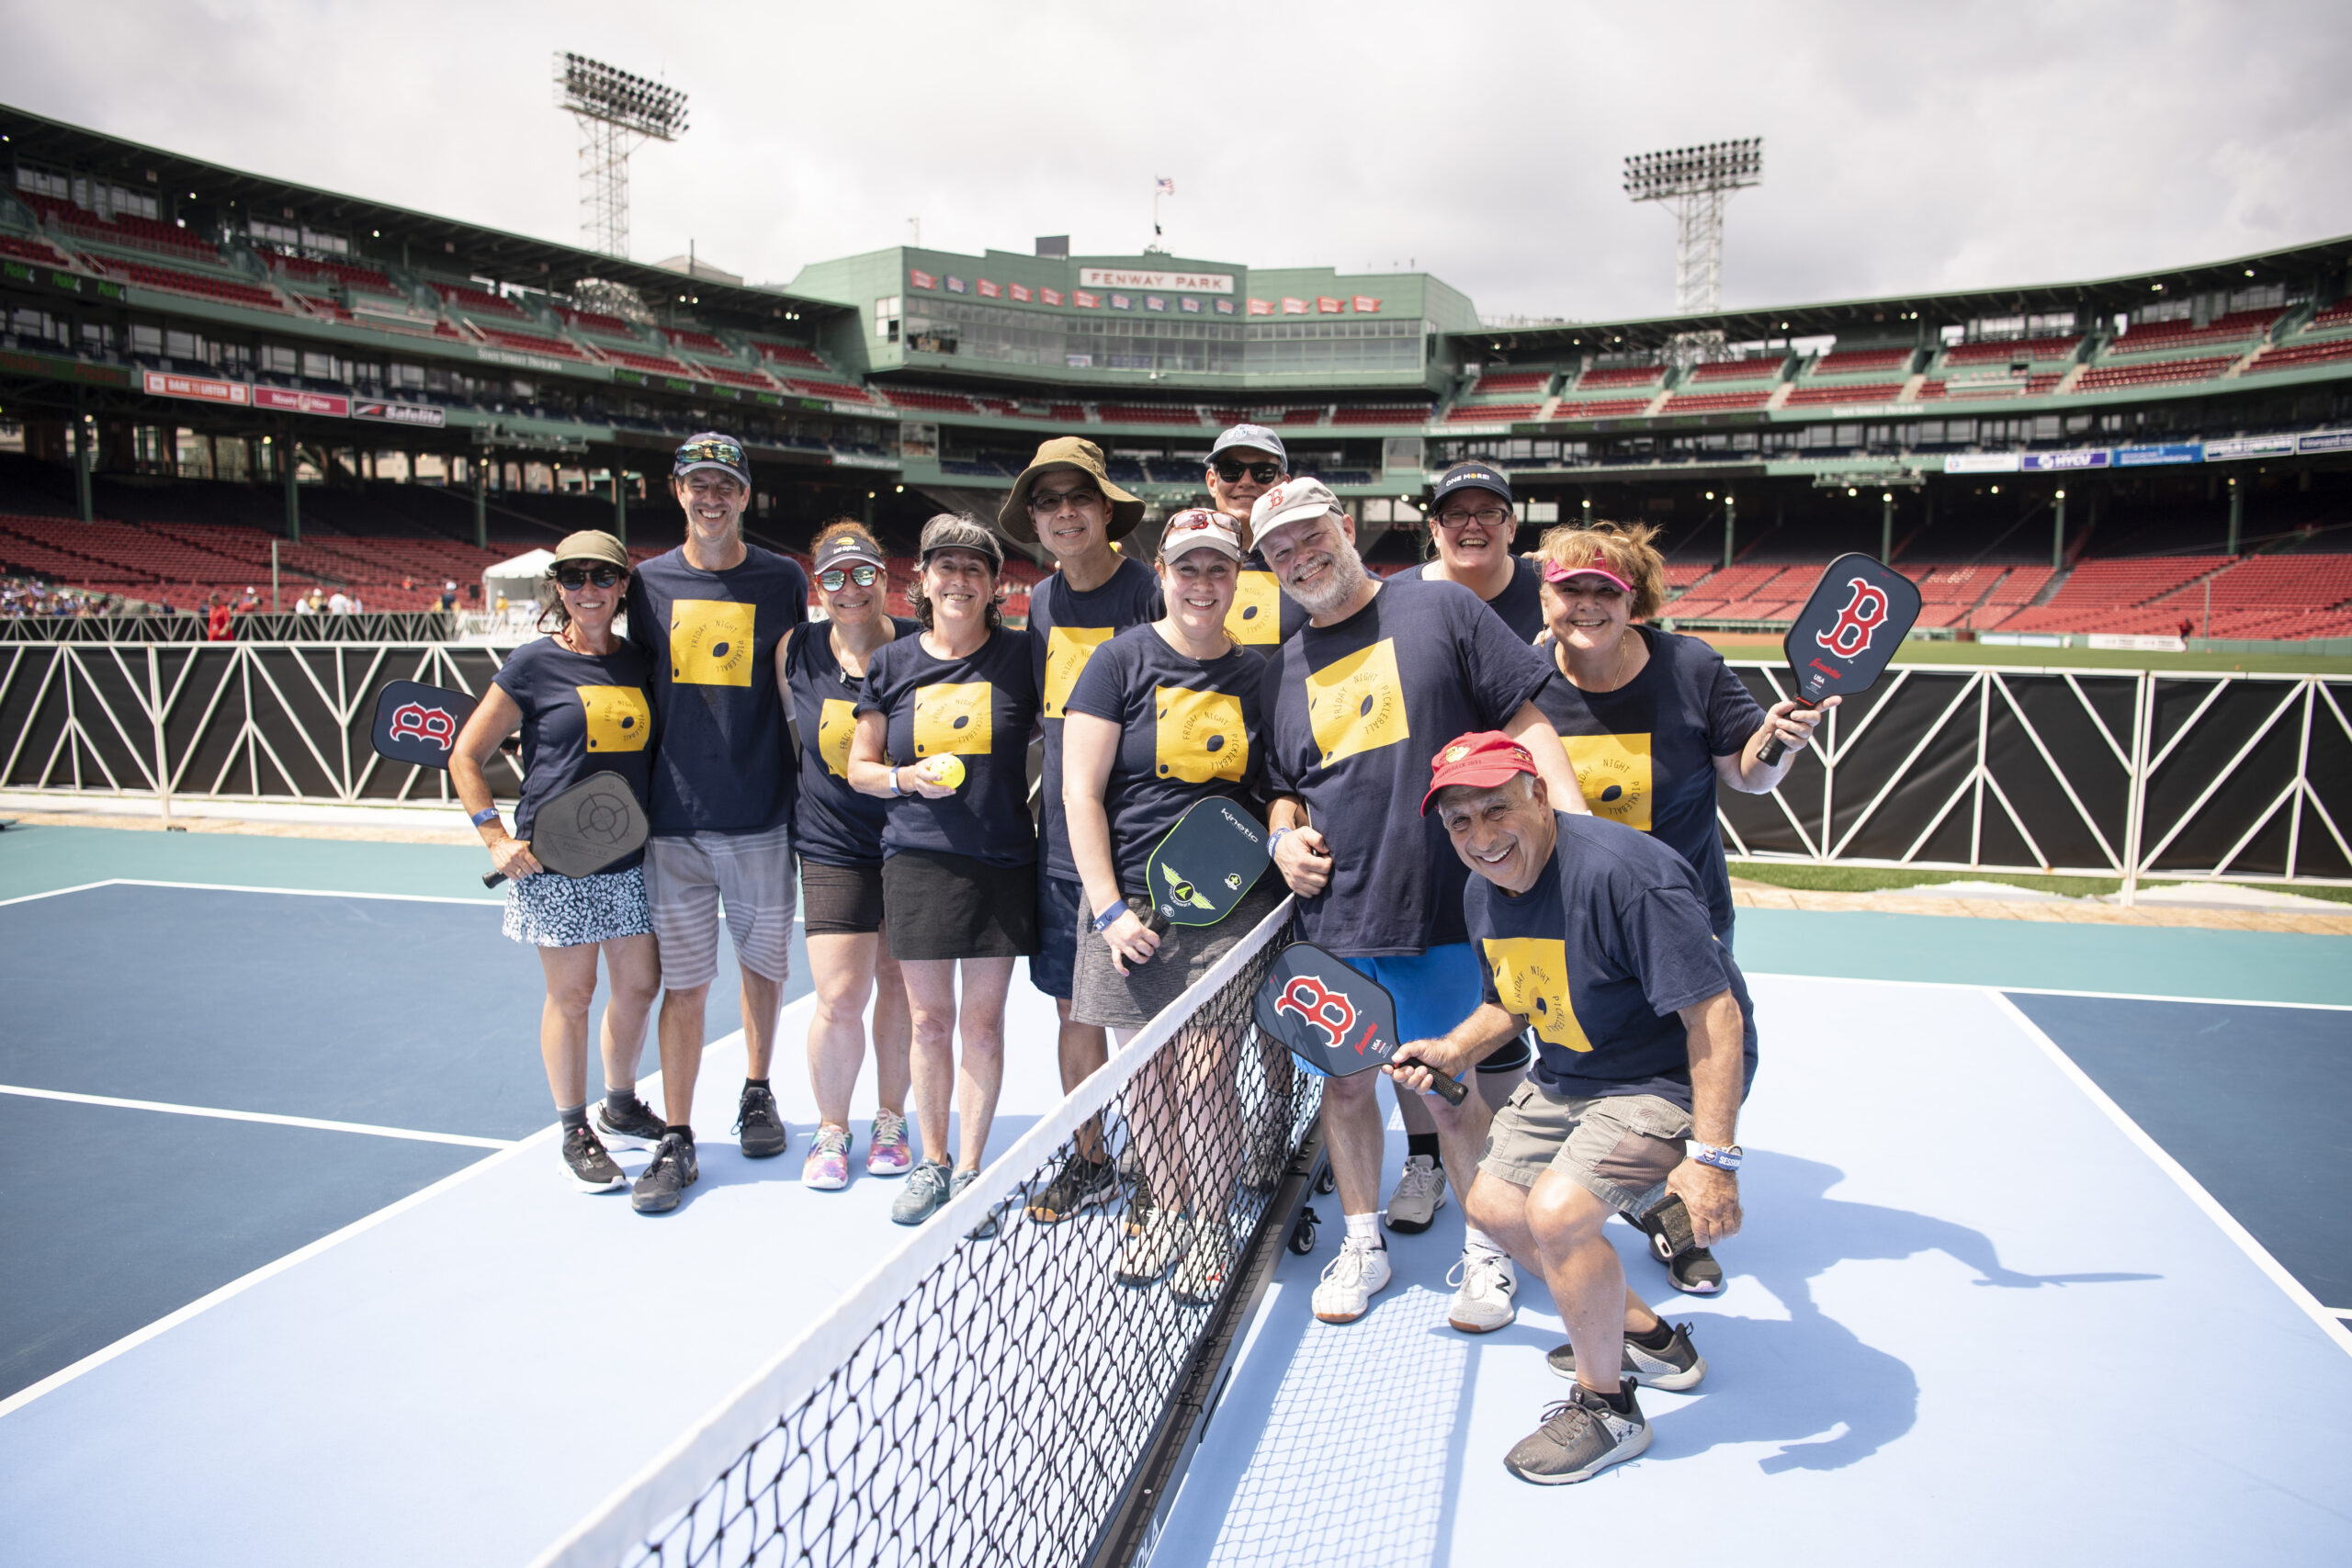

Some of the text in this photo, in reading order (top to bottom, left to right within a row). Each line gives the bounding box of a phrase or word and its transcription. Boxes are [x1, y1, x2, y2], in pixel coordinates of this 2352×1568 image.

[1091, 273, 1222, 288] FENWAY PARK
[167, 378, 229, 397] DARE TO LISTEN
[386, 405, 442, 425] Safelite
[1446, 475, 1462, 487] ONE
[1267, 489, 1284, 511] B
[1816, 577, 1889, 659] B
[691, 620, 745, 673] FRIDAY NIGHT PICKLEBALL
[1061, 654, 1078, 681] FRIDAY
[1814, 673, 1826, 684] USA
[1333, 671, 1392, 735] FRIDAY NIGHT PICKLEBALL
[390, 701, 456, 751] B
[839, 726, 856, 750] FRIDA
[1183, 711, 1239, 770] FRIDAY NIGHT PICKLEBALL
[1579, 759, 1641, 816] IDAY NIGHT PICKLEBALL
[1531, 965, 1551, 985] NIGHT
[1274, 976, 1356, 1048] B
[1371, 1039, 1382, 1051] USA
